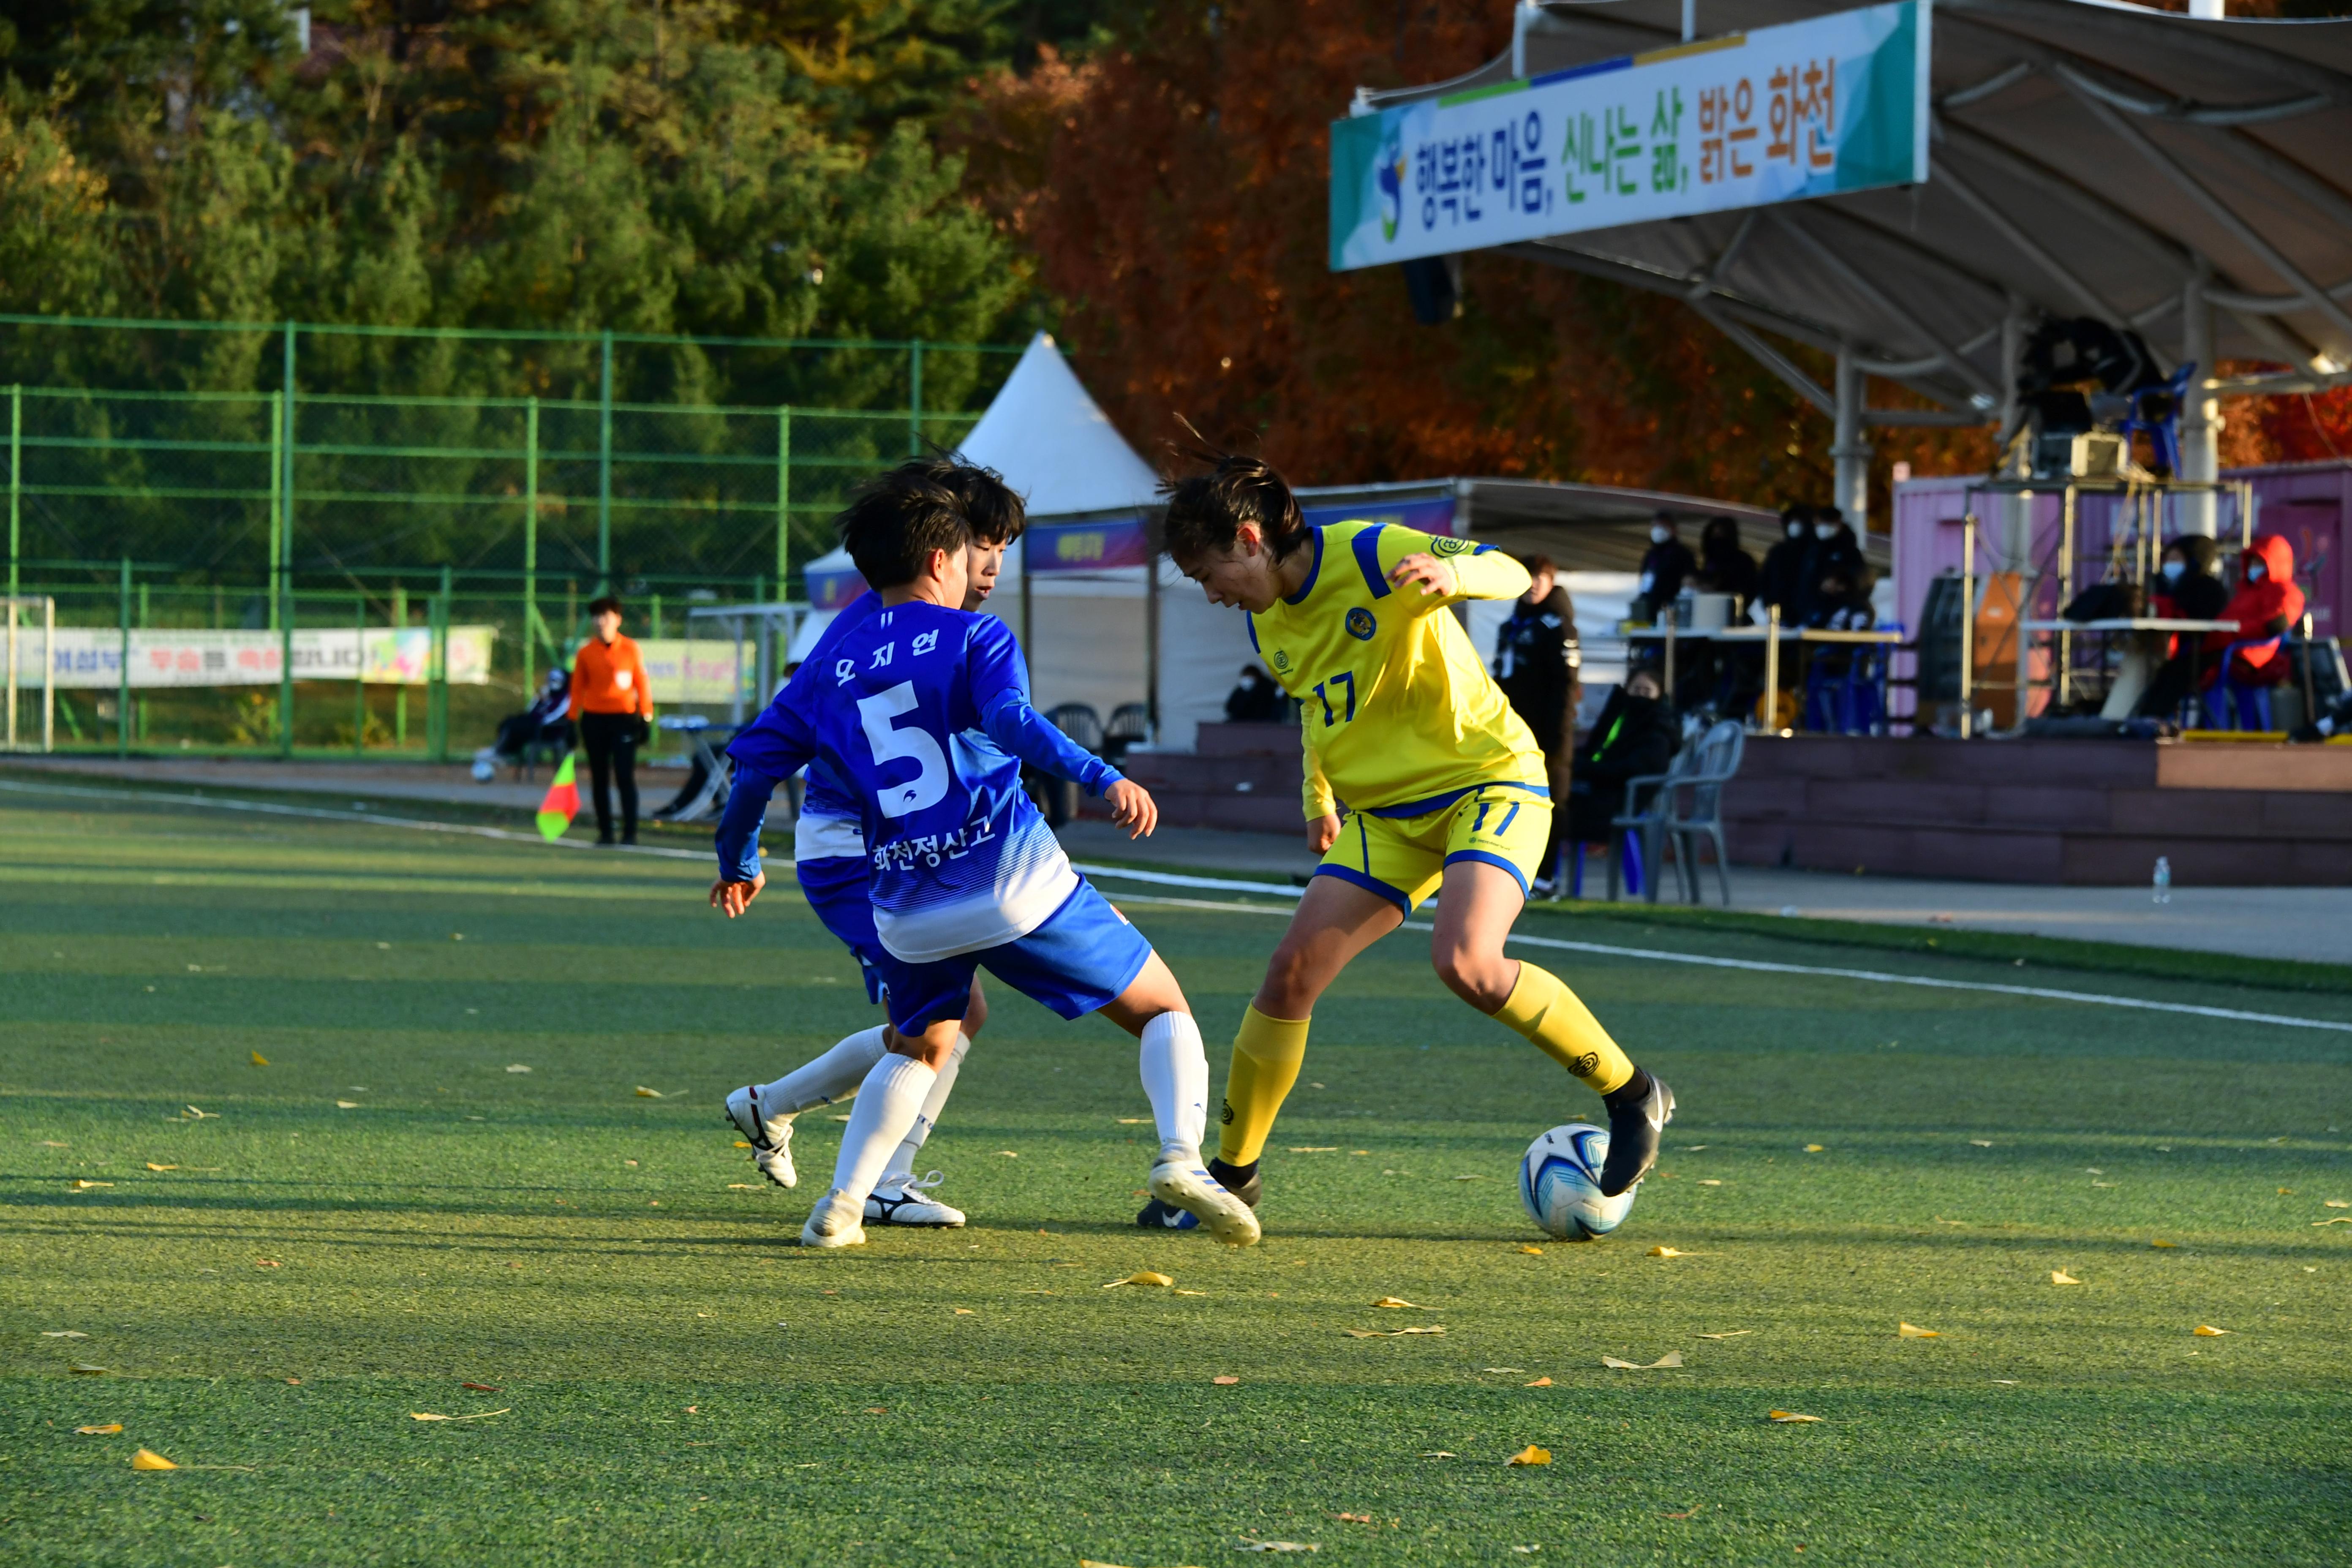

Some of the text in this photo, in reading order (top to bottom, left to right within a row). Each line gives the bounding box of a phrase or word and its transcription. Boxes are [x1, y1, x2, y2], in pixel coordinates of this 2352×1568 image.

[1417, 57, 1835, 231] 행복한 마음, 신나는 삶, 밝은 화천
[1312, 670, 1356, 727] 17
[857, 680, 949, 818] 5
[872, 815, 996, 871] 화천정산고
[1472, 801, 1520, 837] 17
